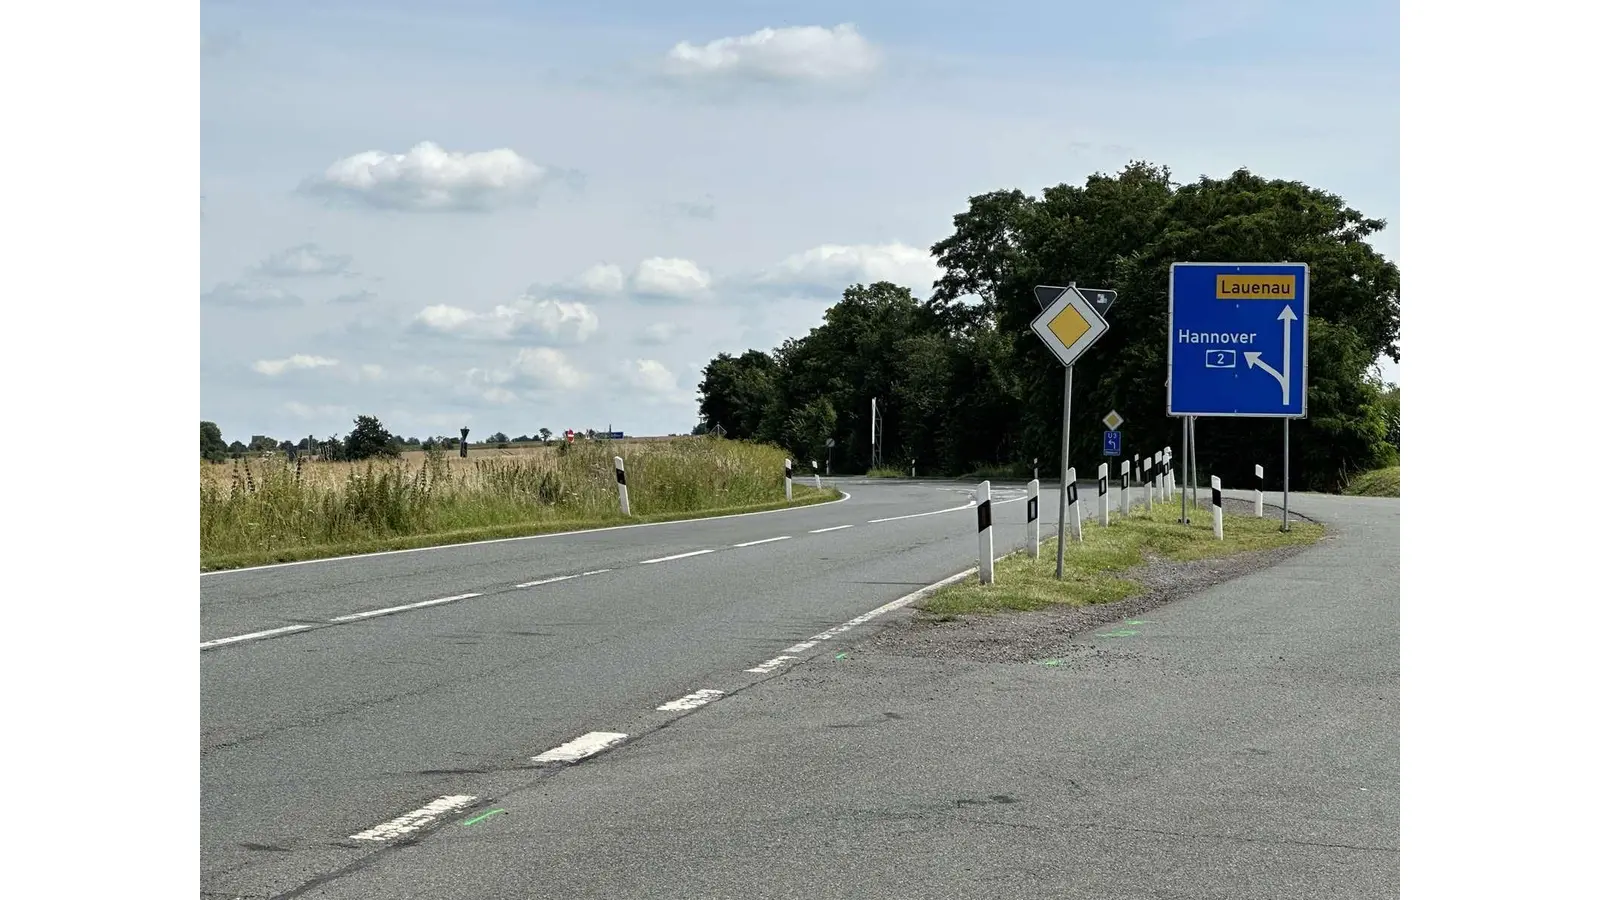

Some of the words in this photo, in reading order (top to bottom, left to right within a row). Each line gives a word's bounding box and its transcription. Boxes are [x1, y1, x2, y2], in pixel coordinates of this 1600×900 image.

[1221, 280, 1290, 294] Lauenau
[1178, 329, 1257, 344] Hannover
[1217, 353, 1225, 365] 2
